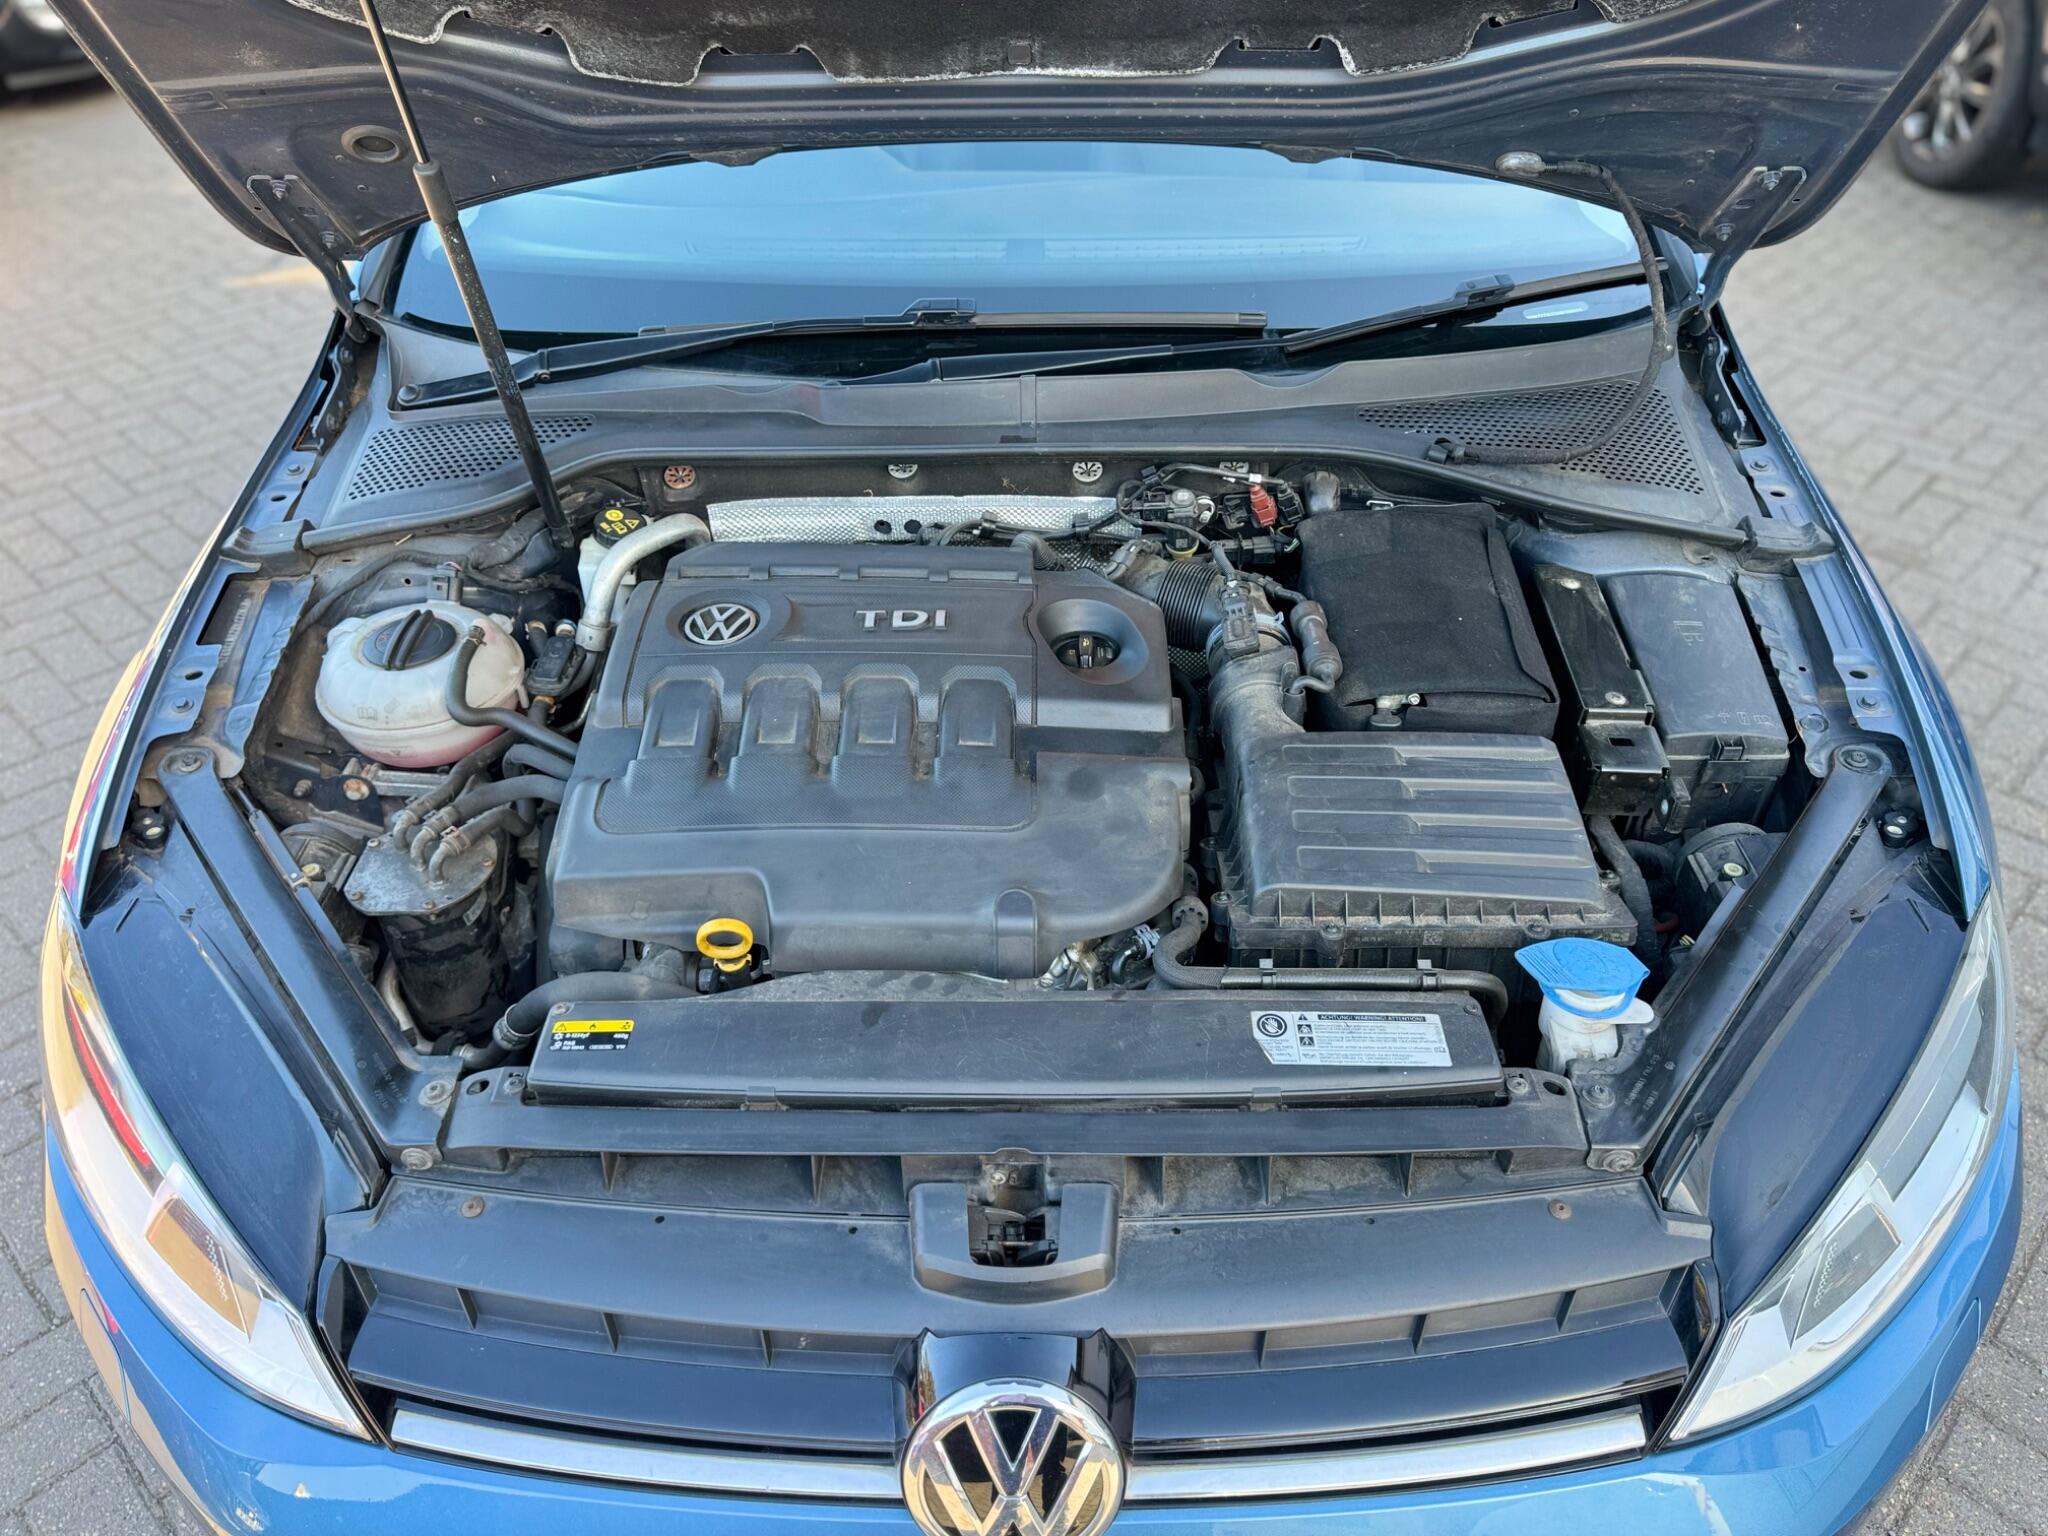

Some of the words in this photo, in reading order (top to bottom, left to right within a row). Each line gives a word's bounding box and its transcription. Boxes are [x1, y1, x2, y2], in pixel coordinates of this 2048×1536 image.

[684, 603, 758, 645] VW
[856, 609, 948, 631] TDI
[908, 1388, 1119, 1536] VW
